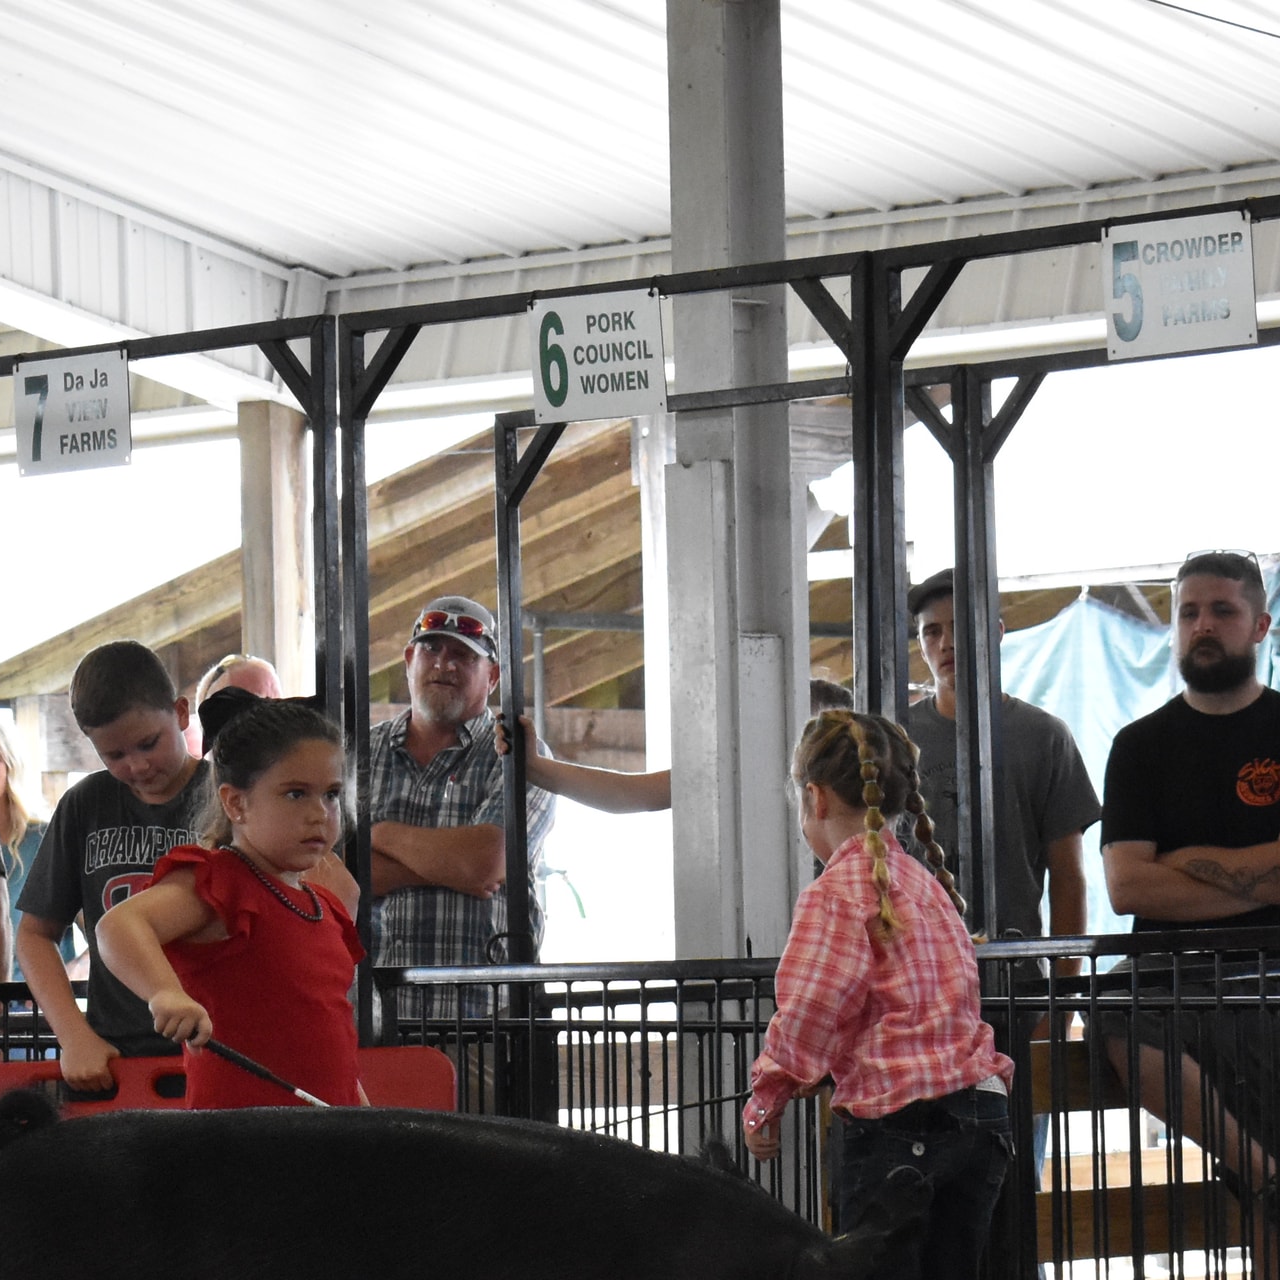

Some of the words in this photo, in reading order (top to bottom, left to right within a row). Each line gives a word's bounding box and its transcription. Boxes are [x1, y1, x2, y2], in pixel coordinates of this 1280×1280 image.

[1142, 231, 1244, 265] CROWDER
[1112, 240, 1143, 342] 5
[587, 310, 636, 334] PORK
[1162, 299, 1231, 327] FARMS
[539, 311, 568, 408] 6
[573, 340, 653, 365] COUNCIL
[63, 372, 84, 392] Da
[89, 368, 108, 389] Ja
[580, 369, 649, 394] WOMEN
[24, 374, 49, 462] 7
[60, 428, 117, 455] FARMS
